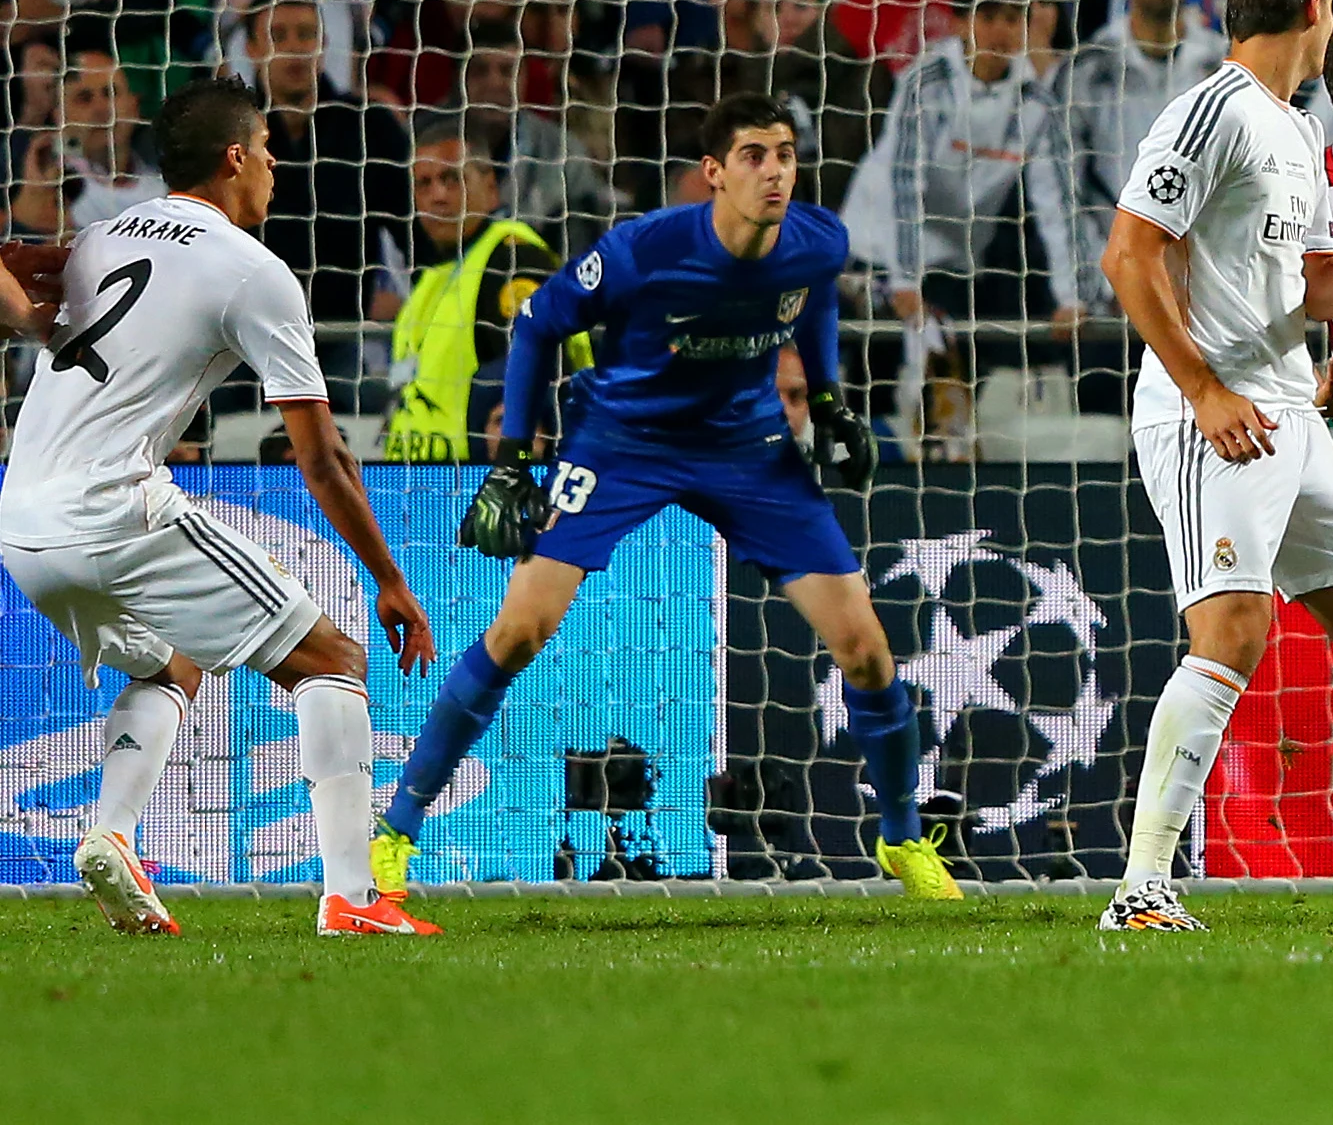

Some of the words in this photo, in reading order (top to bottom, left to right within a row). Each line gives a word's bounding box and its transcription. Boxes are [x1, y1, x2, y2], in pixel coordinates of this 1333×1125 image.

[1289, 195, 1307, 219] Fly
[106, 216, 207, 246] VARANE
[51, 258, 153, 383] 2
[549, 460, 598, 514] 13
